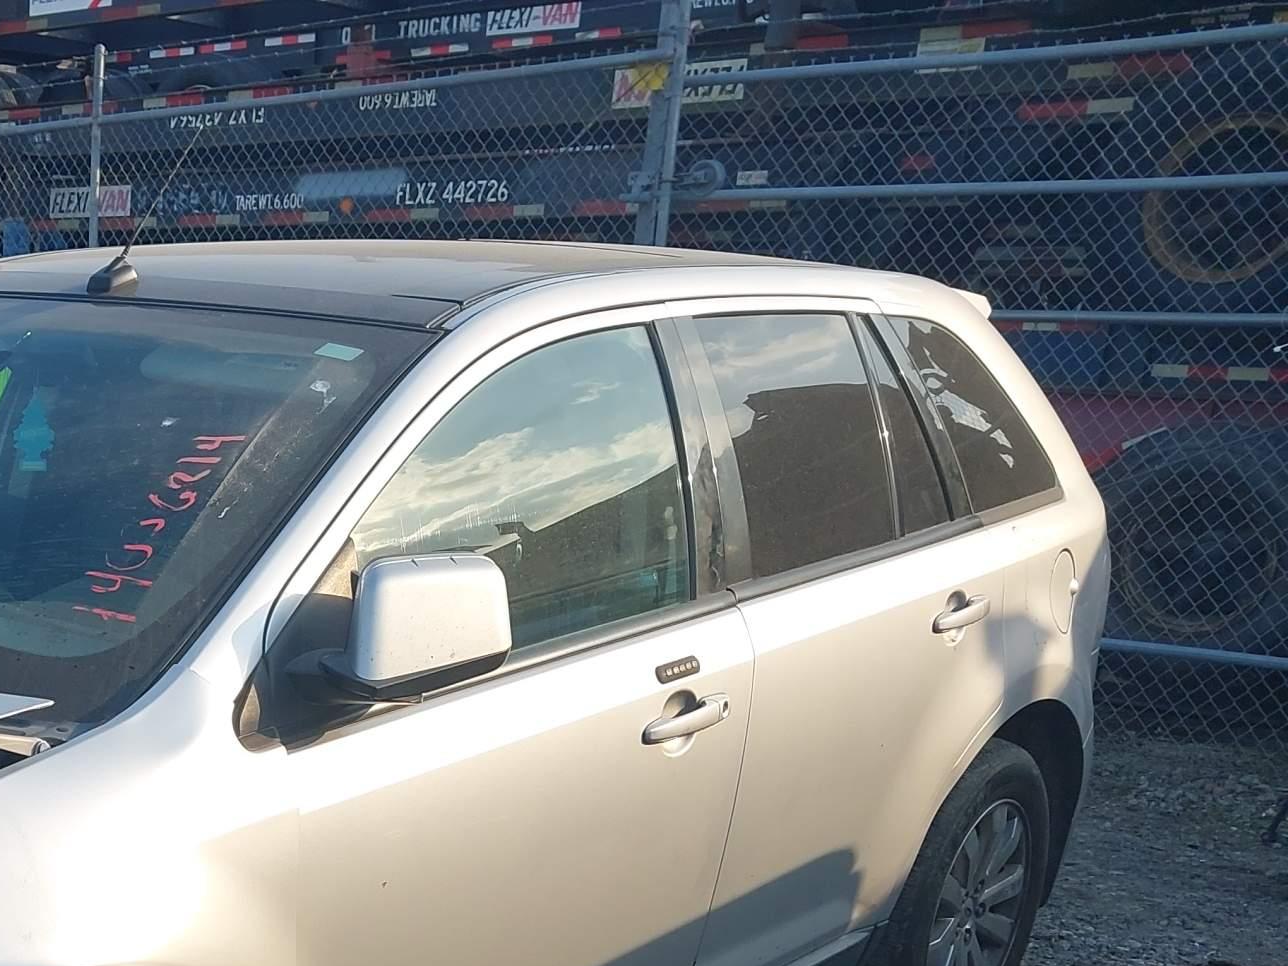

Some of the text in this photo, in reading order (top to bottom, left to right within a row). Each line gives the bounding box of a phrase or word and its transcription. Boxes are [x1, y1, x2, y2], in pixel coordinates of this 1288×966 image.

[398, 13, 481, 39] TRUCKING
[396, 179, 509, 205] FLXZ 442726
